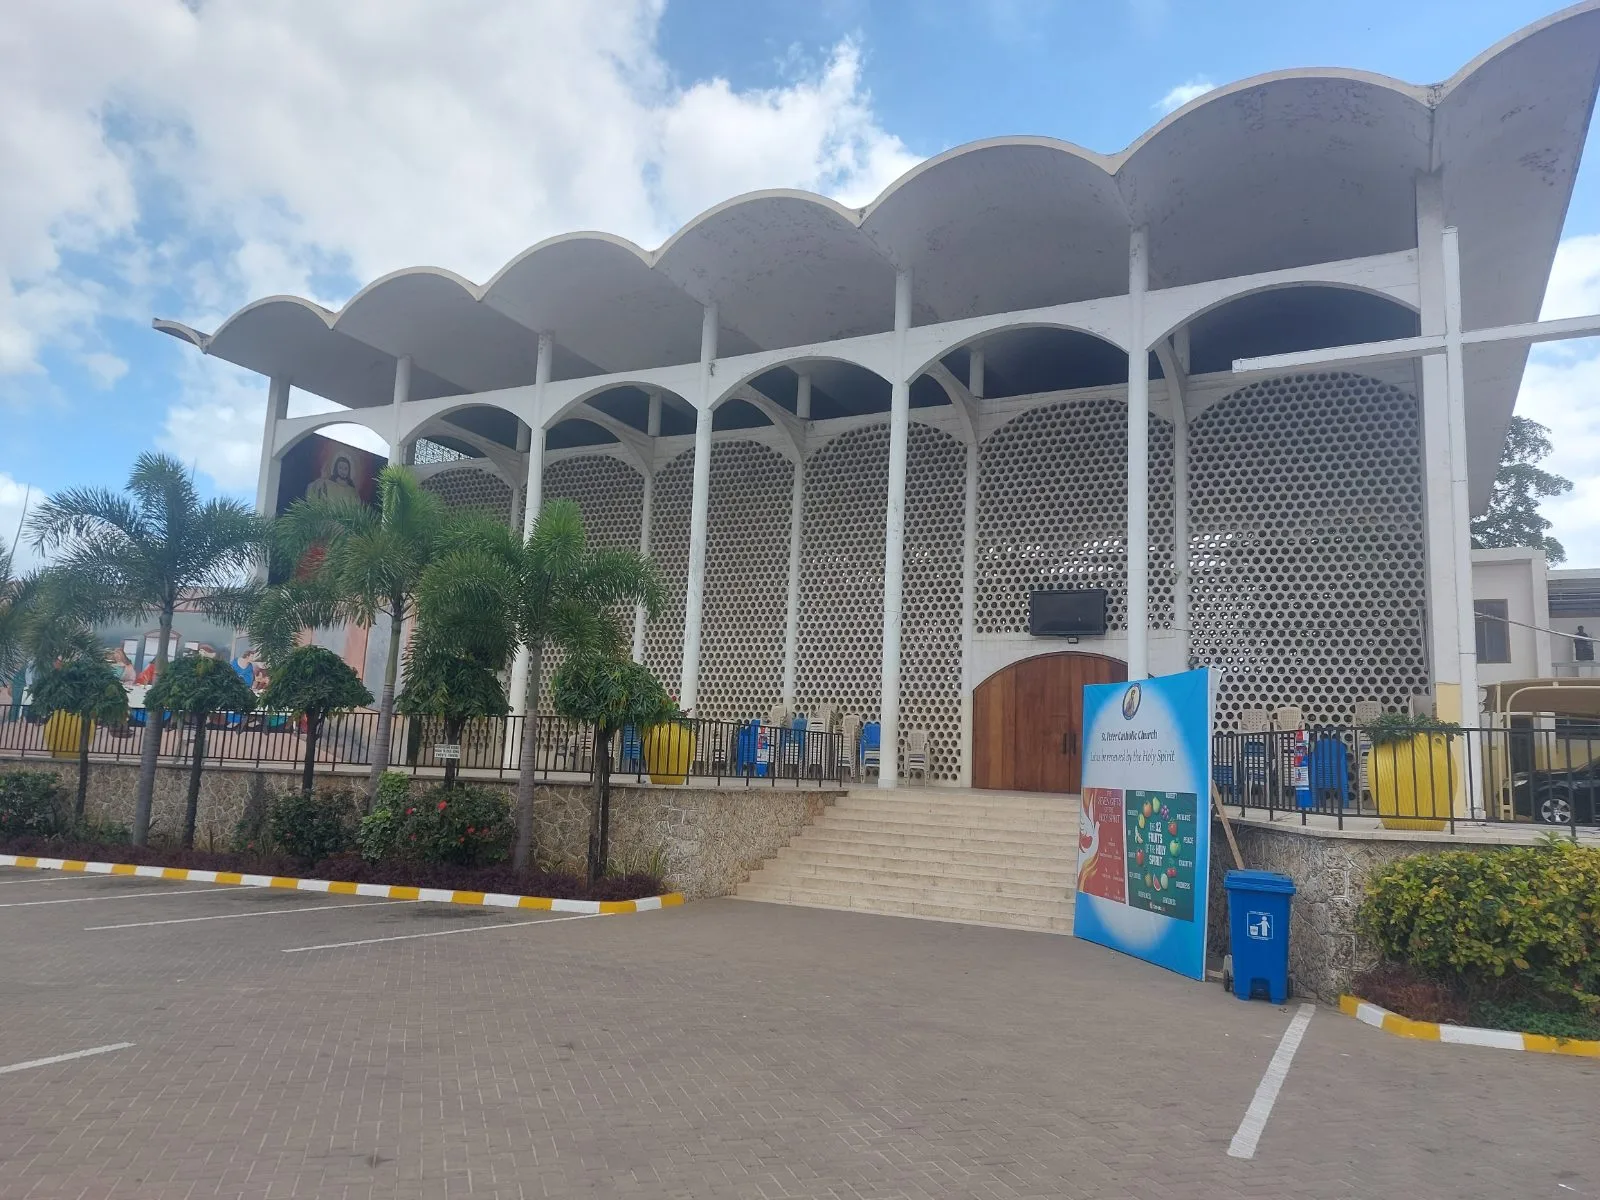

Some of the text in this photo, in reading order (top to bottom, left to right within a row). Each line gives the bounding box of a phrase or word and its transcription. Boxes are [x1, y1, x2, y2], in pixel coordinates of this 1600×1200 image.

[1107, 732, 1118, 742] Peter
[1118, 731, 1138, 741] Catholic
[1138, 729, 1158, 740] Church
[1127, 749, 1133, 766] by
[1133, 749, 1142, 763] the
[1143, 749, 1156, 766] Holy
[1157, 749, 1175, 763] Spirit
[1155, 822, 1162, 832] 12
[1149, 832, 1162, 843] FRUITS
[1155, 844, 1166, 856] HOLY
[1149, 855, 1162, 867] SPIRIT
